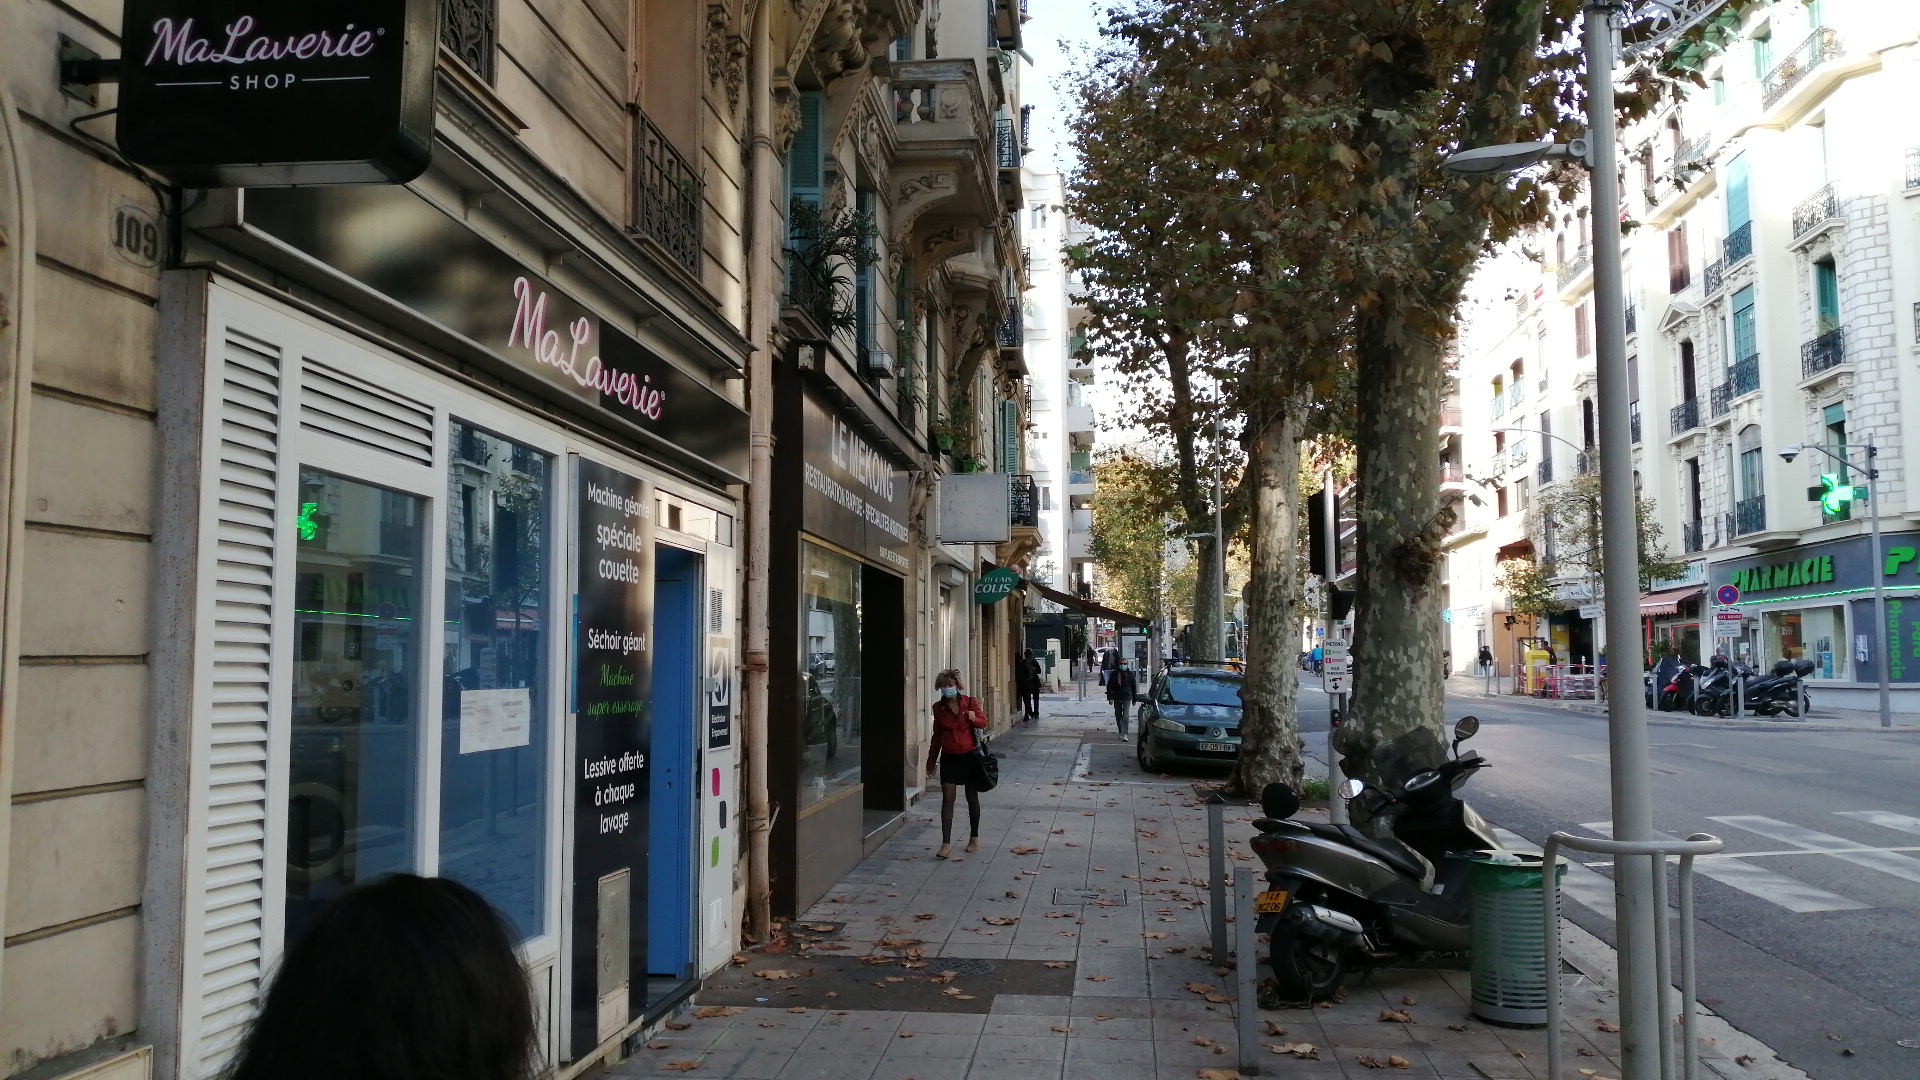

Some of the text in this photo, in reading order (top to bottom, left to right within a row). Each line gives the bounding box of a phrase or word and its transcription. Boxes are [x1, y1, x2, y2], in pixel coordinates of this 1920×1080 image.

[230, 73, 296, 90] SHOP
[114, 211, 159, 262] 109
[831, 414, 894, 503] LE MEKONG
[588, 481, 650, 519] Machine géante
[805, 461, 846, 508] RESTAURATION
[845, 489, 863, 517] RAPIDE
[596, 522, 642, 553] spéciale
[599, 558, 639, 584] couette
[1731, 555, 1834, 593] PHARMACIE
[974, 583, 1011, 594] COLIS
[588, 627, 646, 656] Séchoir géant
[1888, 600, 1906, 680] pharmacie
[600, 663, 634, 687] Machine
[588, 700, 644, 722] super essorage
[584, 750, 644, 780] Lessive offerte
[595, 782, 635, 807] à chaque
[600, 811, 629, 835] lavage
